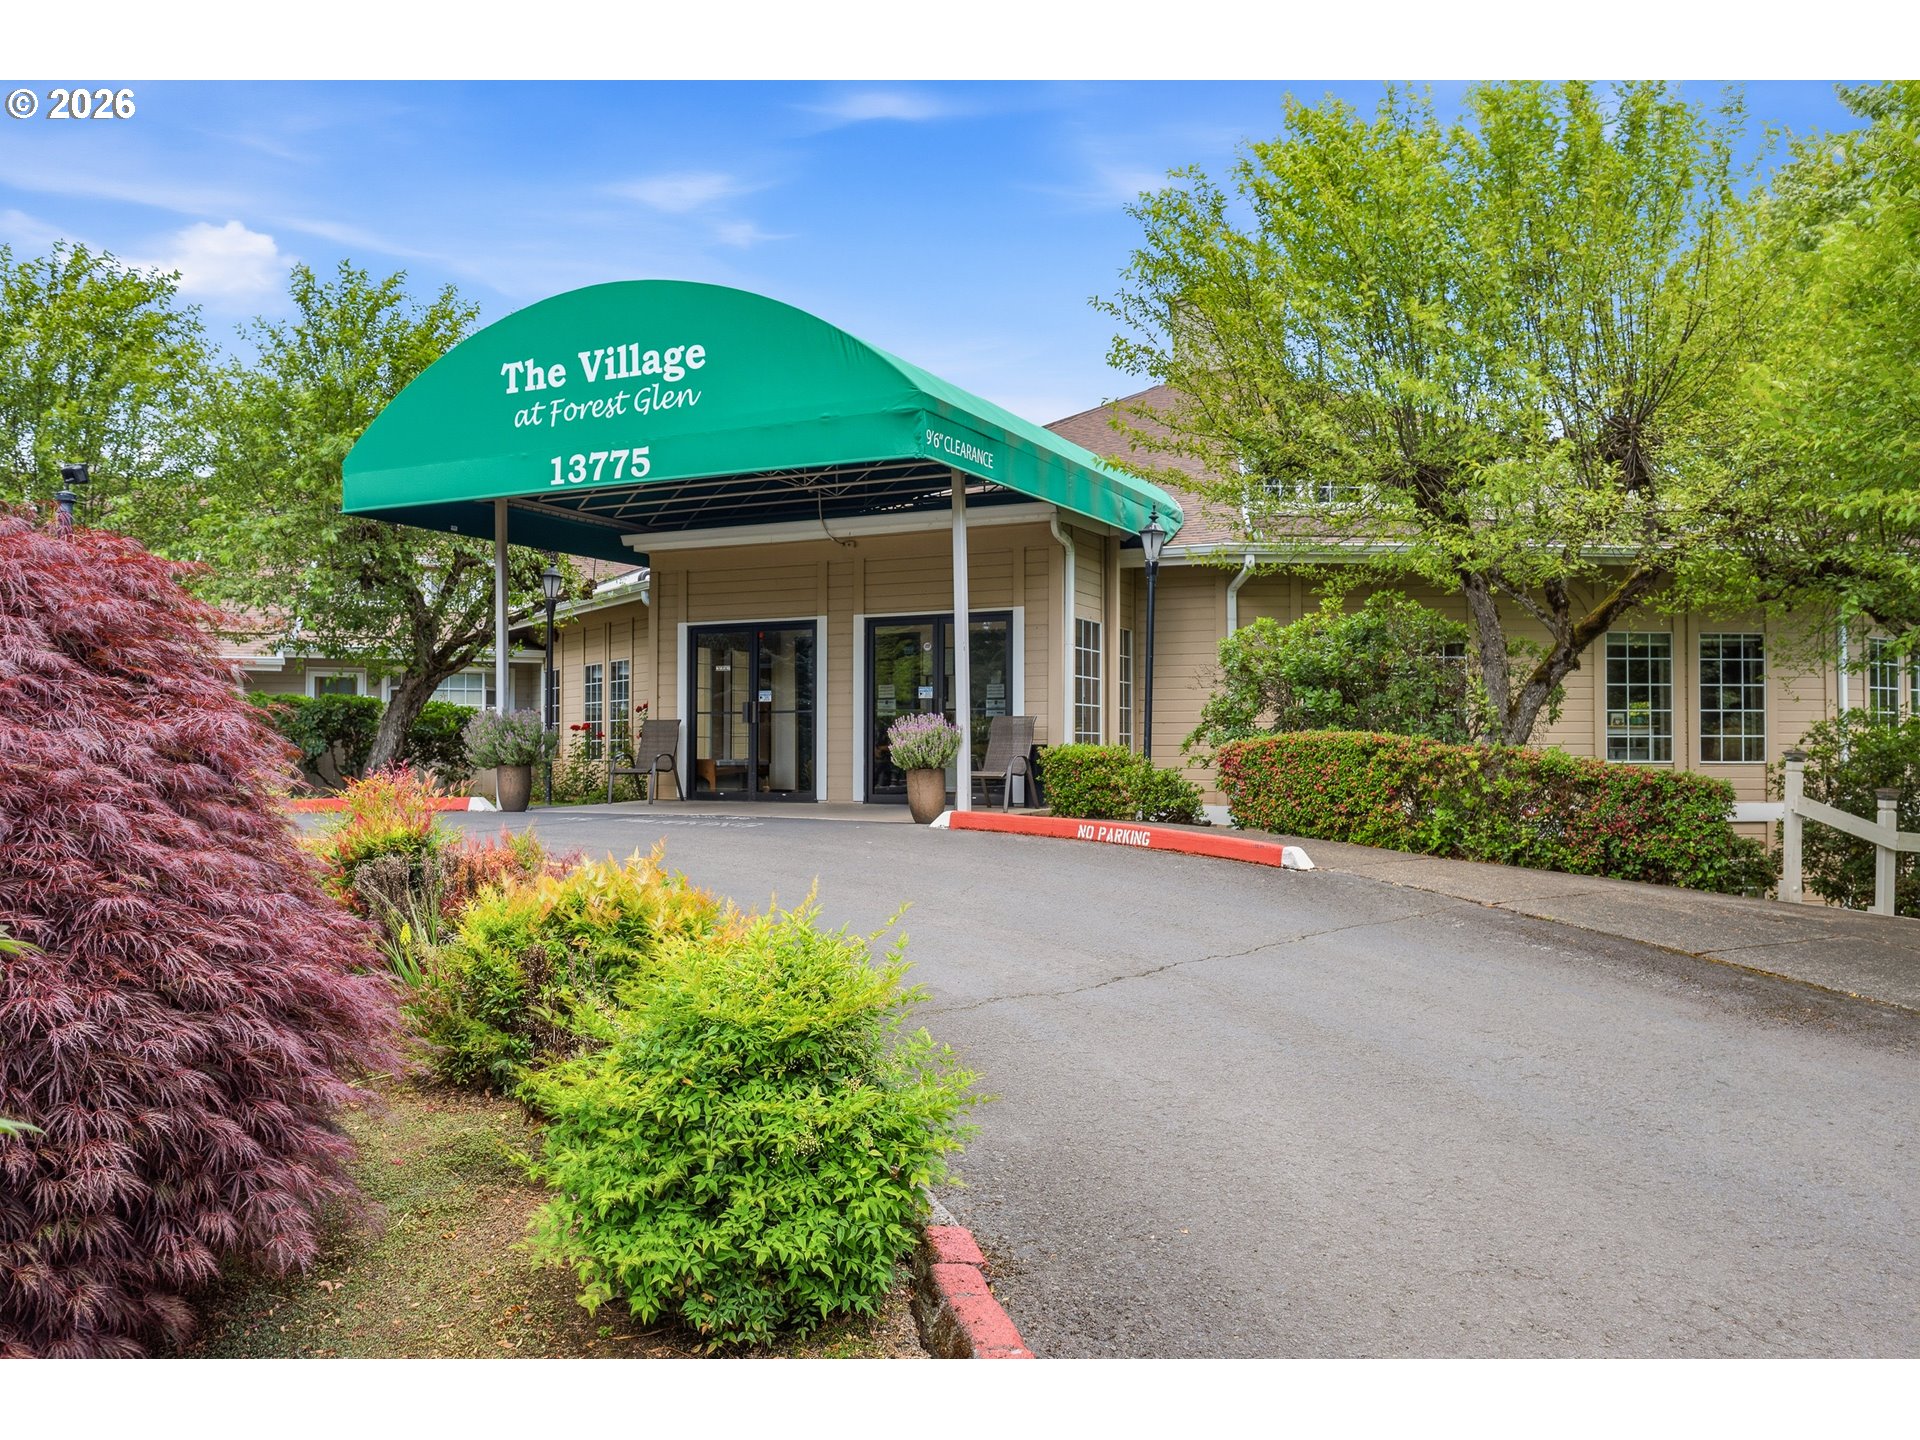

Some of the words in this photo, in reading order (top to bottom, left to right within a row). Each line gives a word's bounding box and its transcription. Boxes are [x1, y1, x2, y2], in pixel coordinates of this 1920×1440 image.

[501, 358, 567, 394] The
[578, 342, 706, 382] Village
[514, 402, 546, 428] at
[550, 390, 630, 428] Forest
[633, 383, 701, 415] Glen
[550, 446, 651, 485] 13775
[944, 436, 994, 469] CLEARANCE
[1077, 824, 1095, 840] NO
[1097, 826, 1151, 846] PARKING
